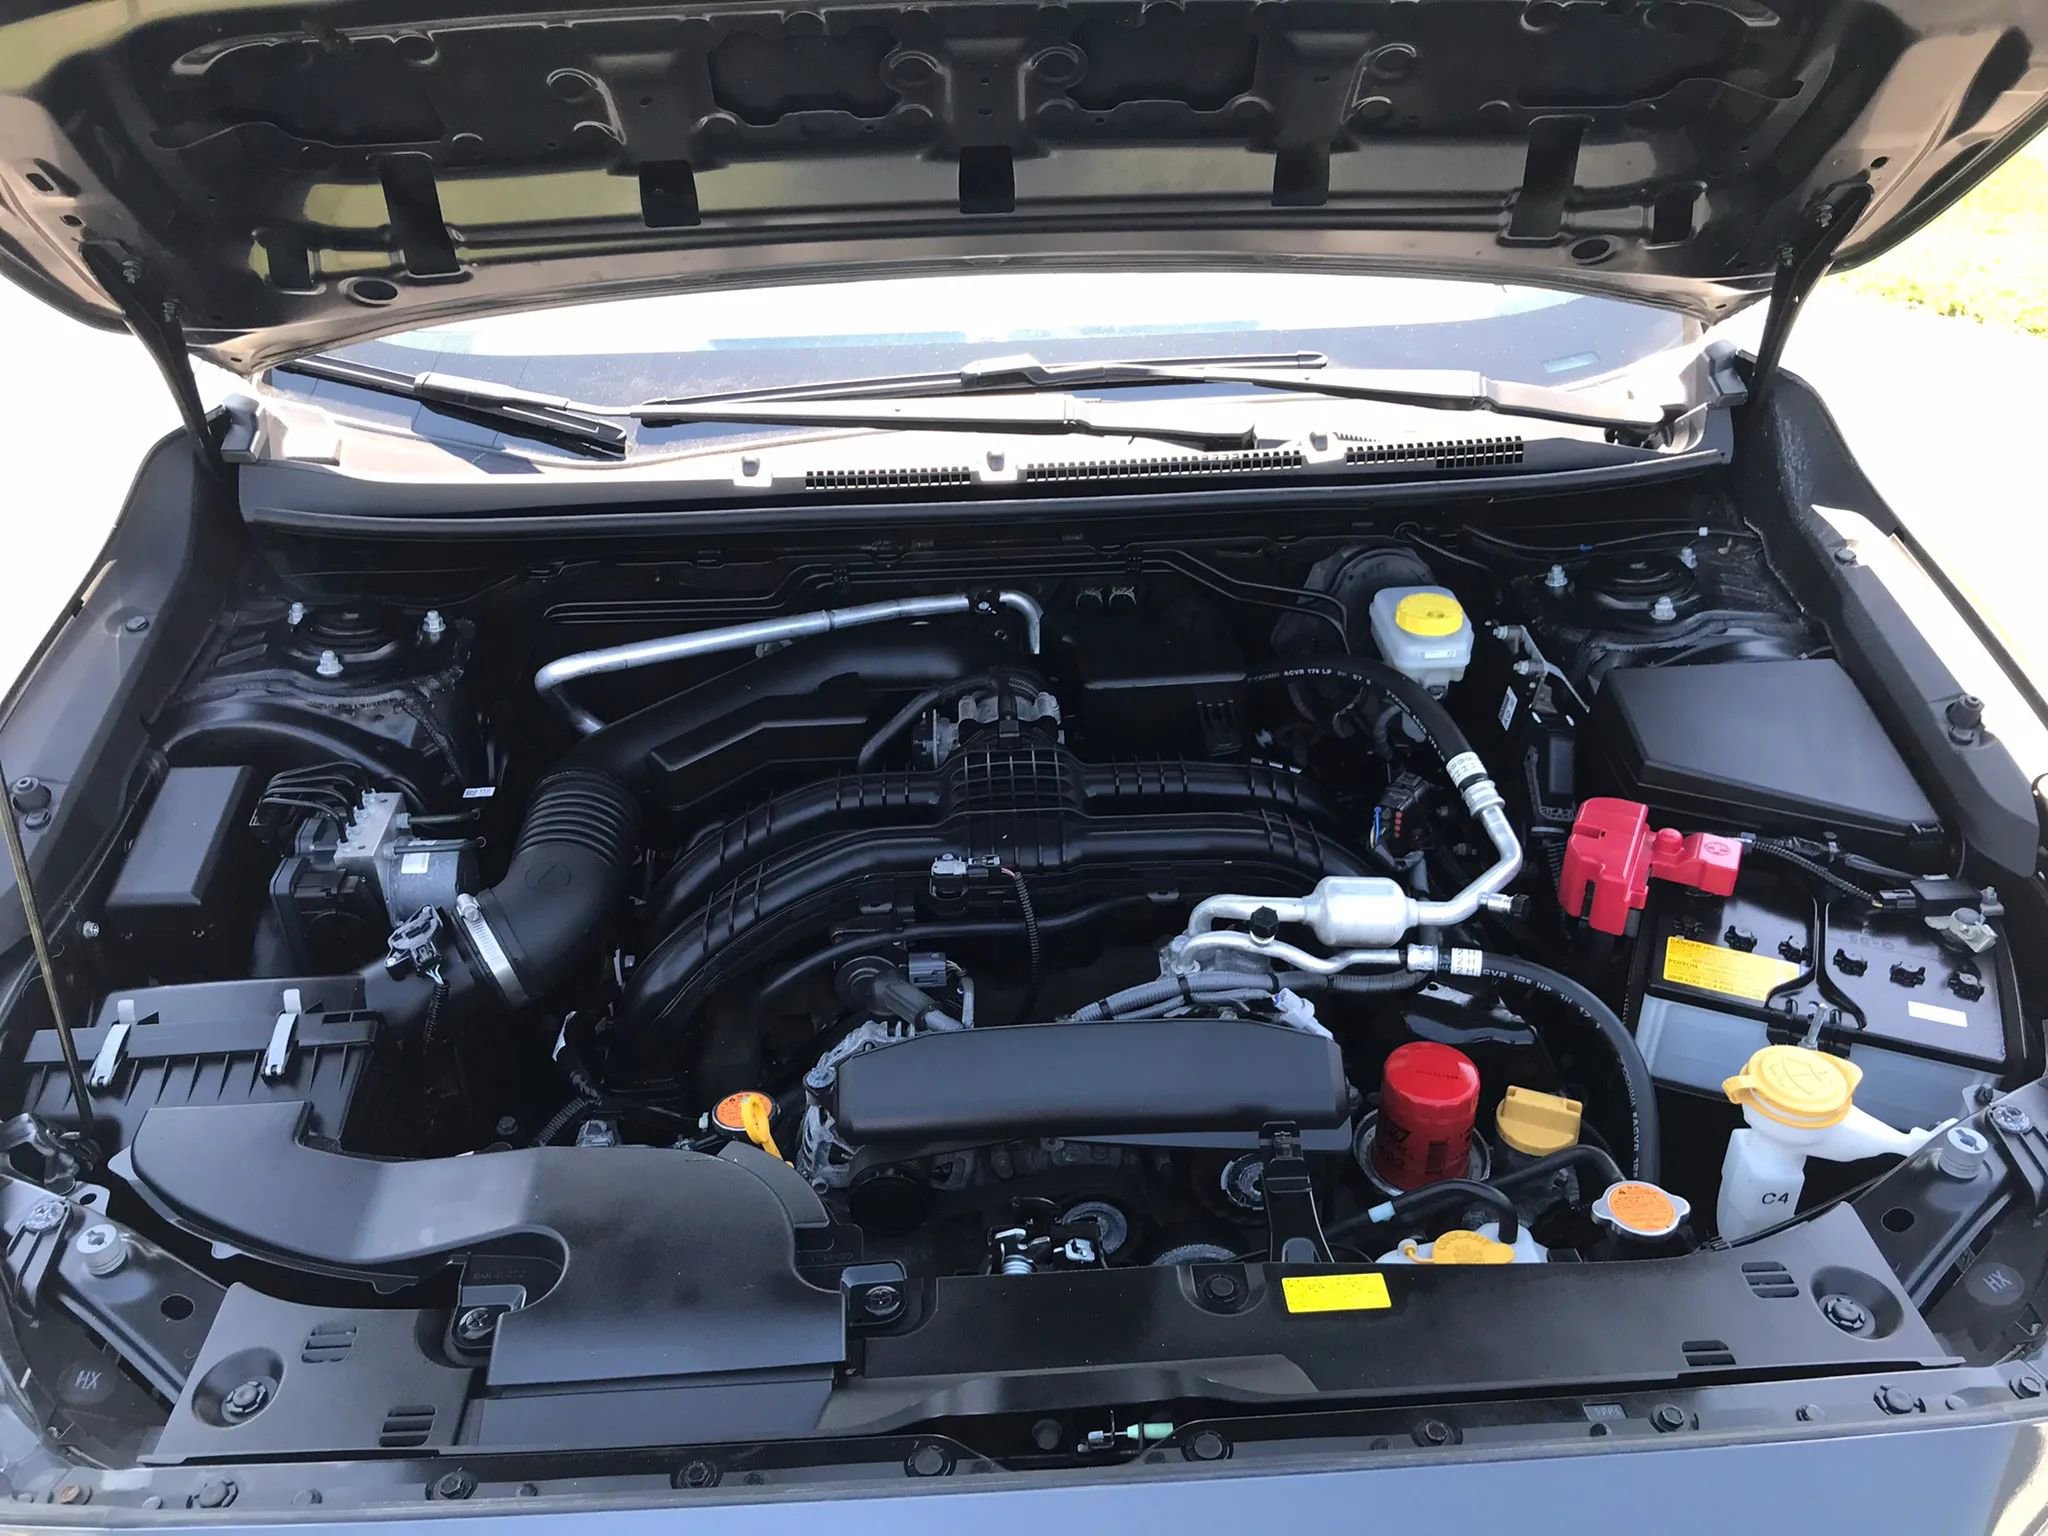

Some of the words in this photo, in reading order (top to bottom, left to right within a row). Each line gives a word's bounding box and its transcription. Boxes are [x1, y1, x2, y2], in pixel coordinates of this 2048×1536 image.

[1761, 1191, 1790, 1205] C4
[1982, 1270, 2013, 1293] HX
[74, 1369, 102, 1390] HX
